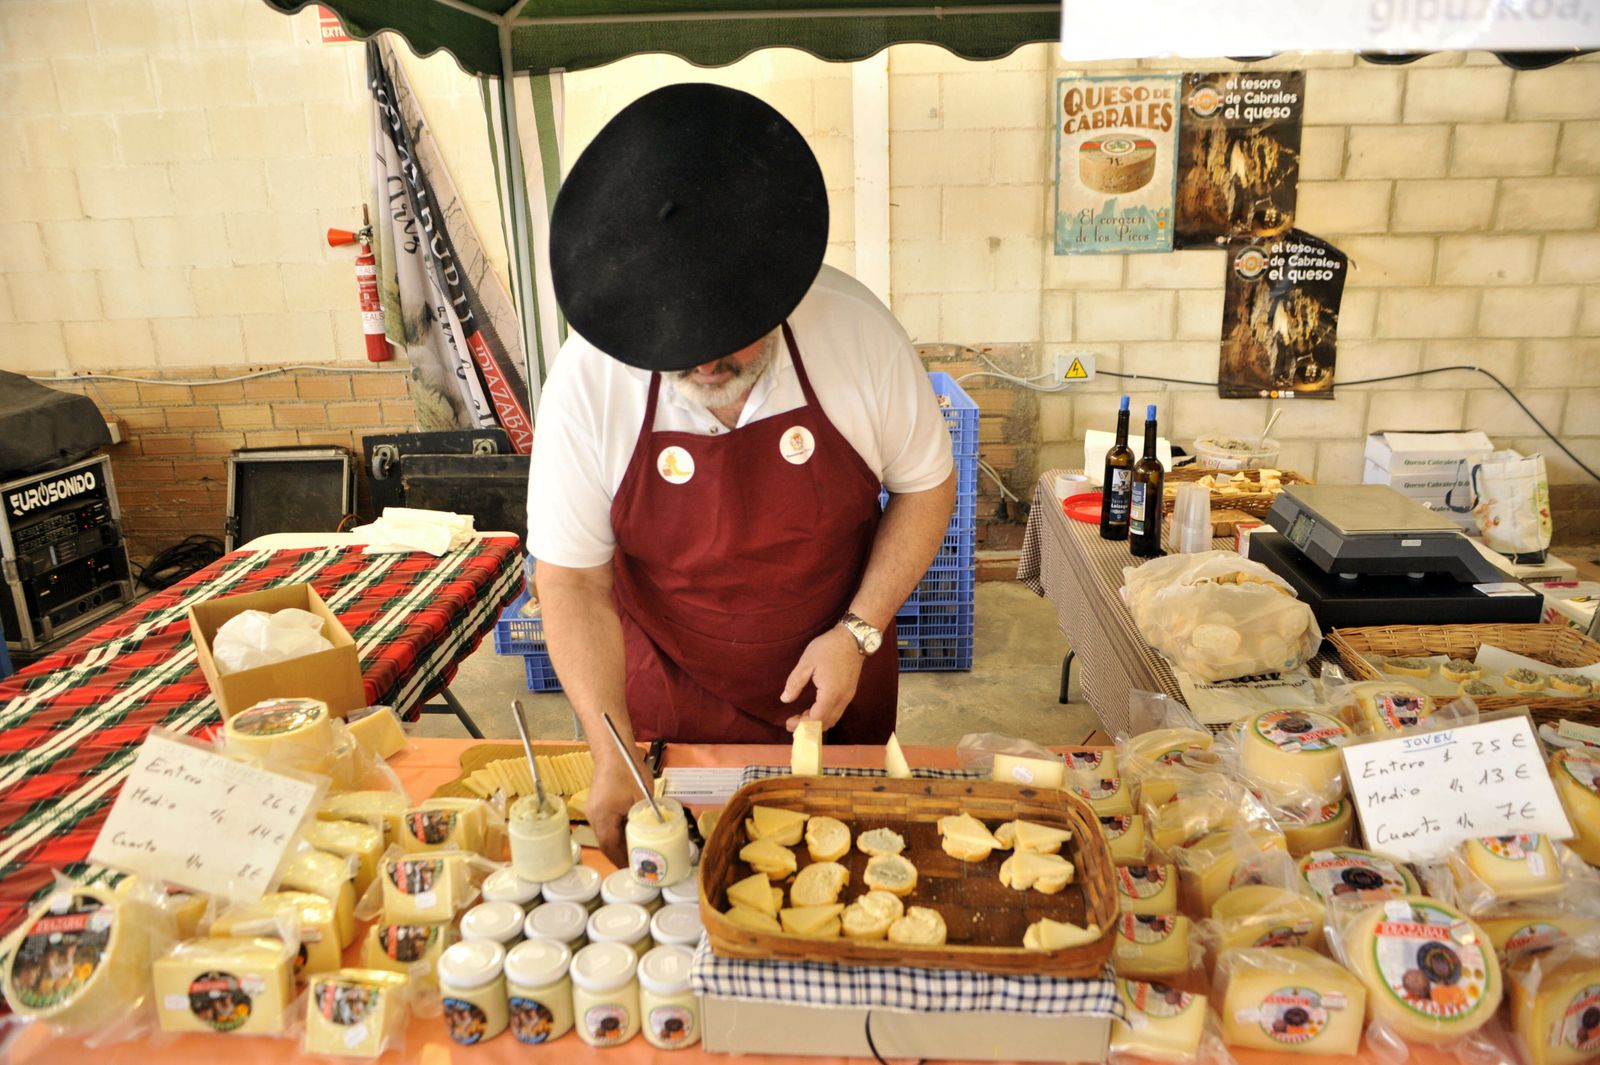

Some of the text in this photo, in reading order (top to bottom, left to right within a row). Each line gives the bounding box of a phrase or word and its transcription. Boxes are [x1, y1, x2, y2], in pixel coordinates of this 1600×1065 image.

[1225, 78, 1281, 90] el tesoro
[1063, 86, 1171, 116] QUESO DE
[1225, 92, 1298, 105] de Cabrales
[1063, 101, 1173, 134] CABRALES
[1224, 105, 1291, 122] el queso
[1079, 208, 1096, 226] El
[1075, 225, 1150, 243] de los Picos
[1271, 242, 1325, 256] el tesoro
[1270, 255, 1341, 270] de Cabrales
[1269, 267, 1334, 284] el queso
[1404, 481, 1426, 489] Queso
[1403, 732, 1455, 749] JOVEN
[1362, 733, 1527, 779] Entero 1 25 €
[1368, 786, 1421, 808] Medio
[1478, 767, 1506, 786] 13
[1514, 763, 1531, 779] €
[262, 793, 280, 810] 26
[248, 824, 271, 840] 14
[1376, 815, 1441, 845] Cuarto
